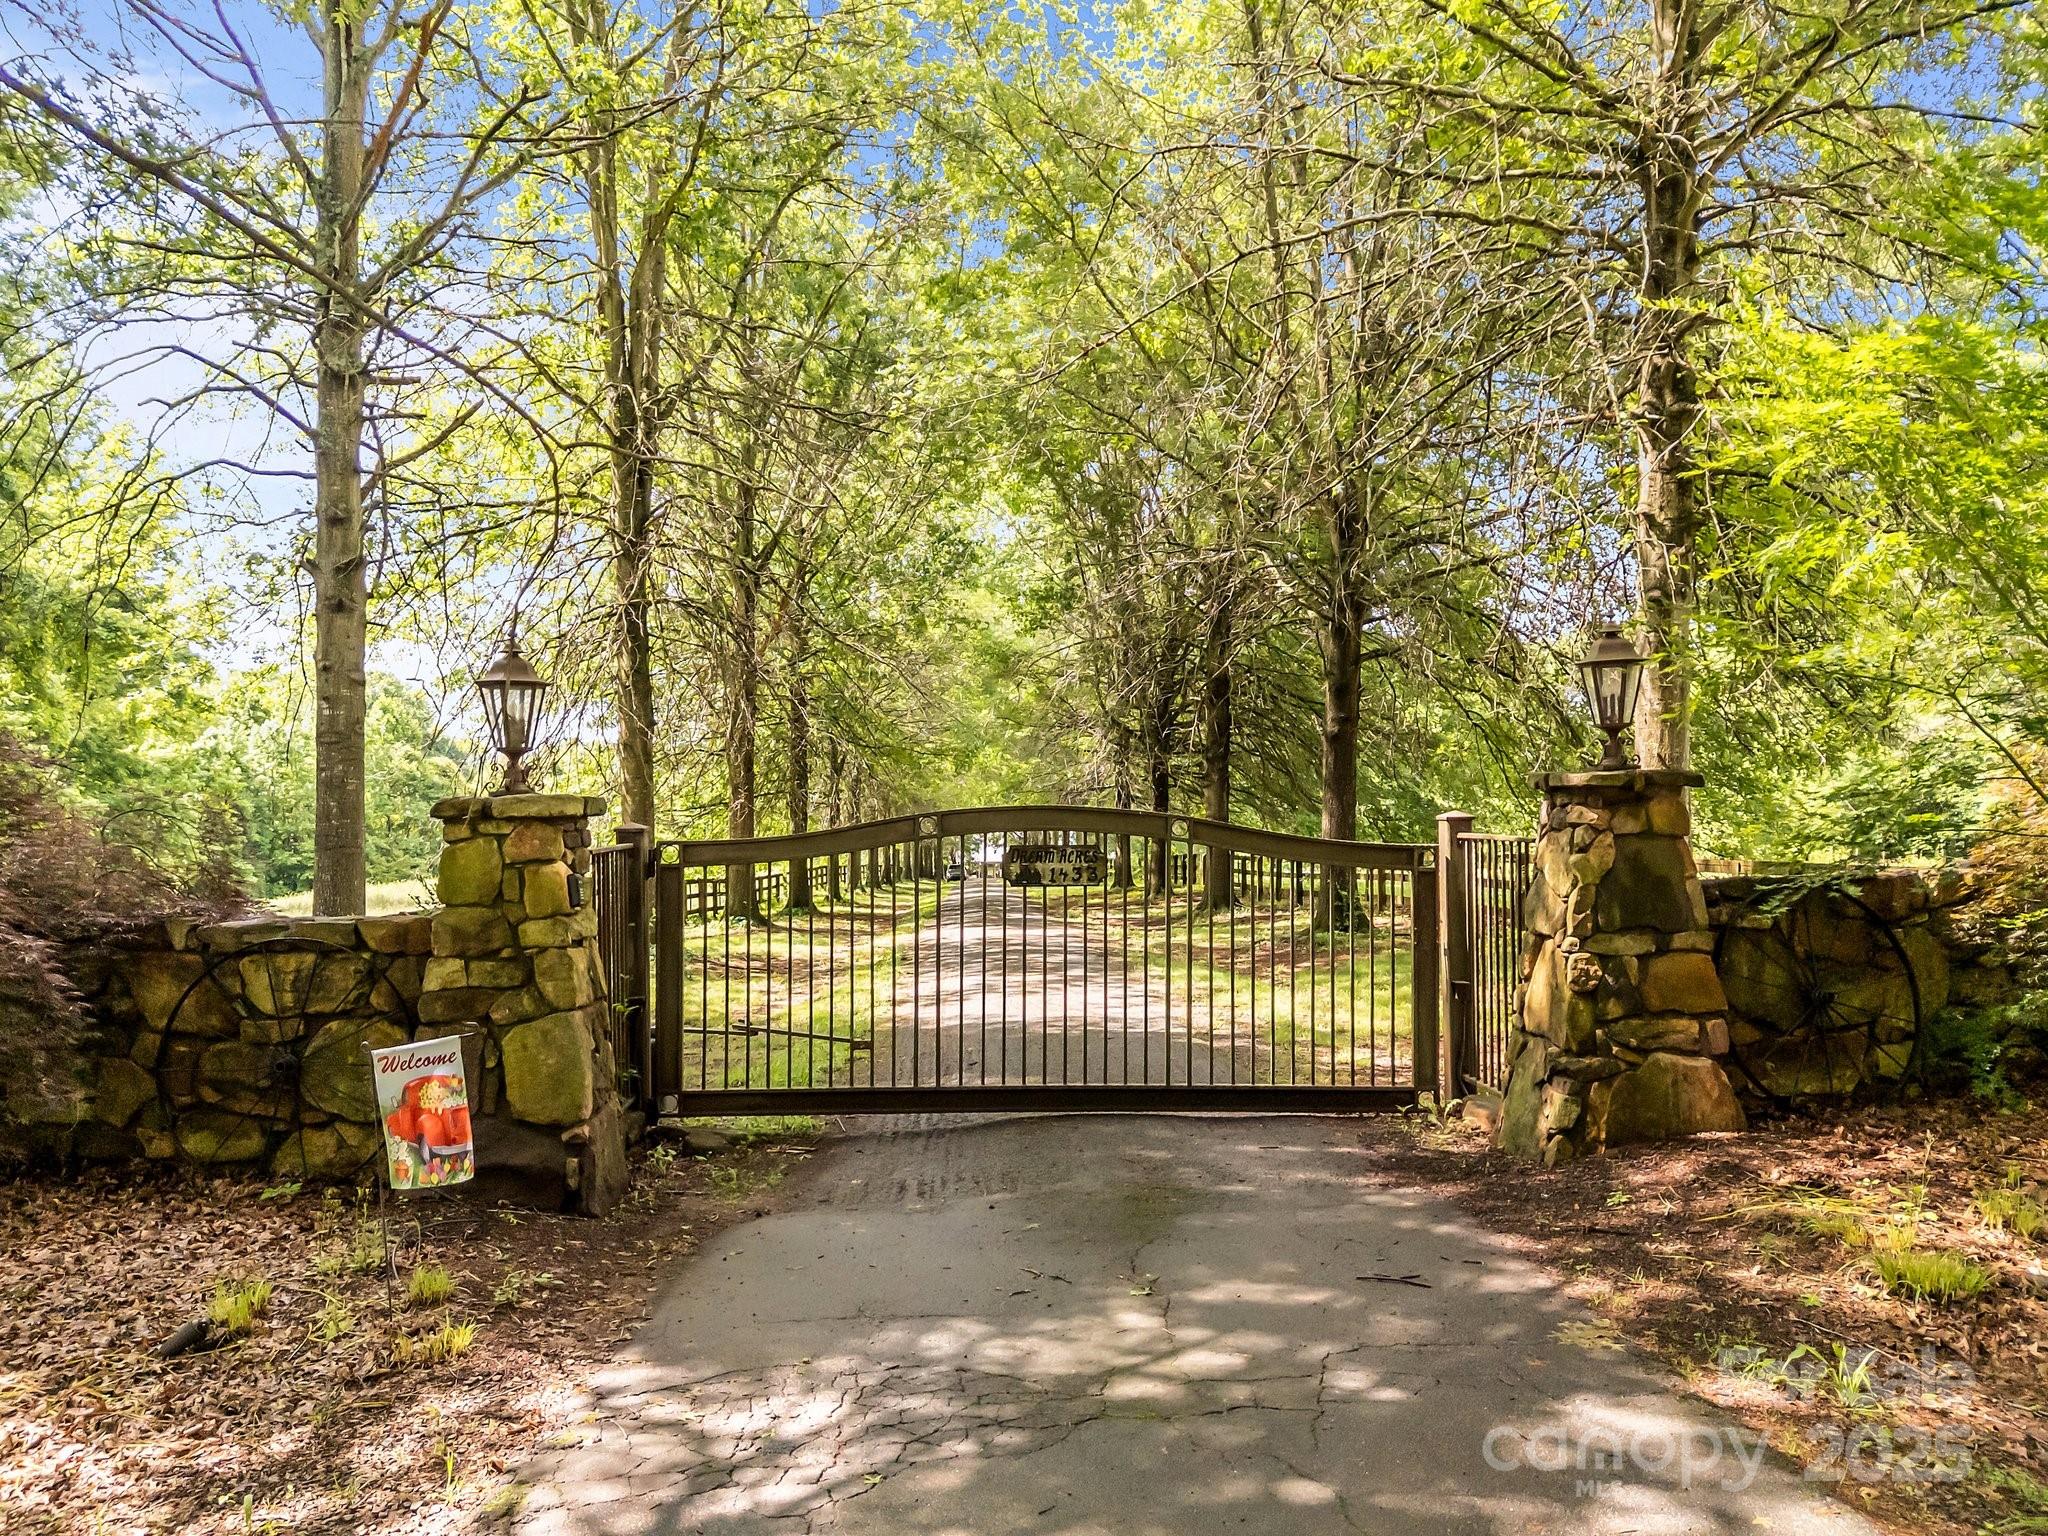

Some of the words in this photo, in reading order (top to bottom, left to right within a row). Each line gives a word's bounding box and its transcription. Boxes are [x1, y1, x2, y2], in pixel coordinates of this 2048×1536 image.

[1059, 848, 1098, 864] ACRES
[1048, 866, 1098, 883] 1433
[377, 1051, 457, 1074] Welcome
